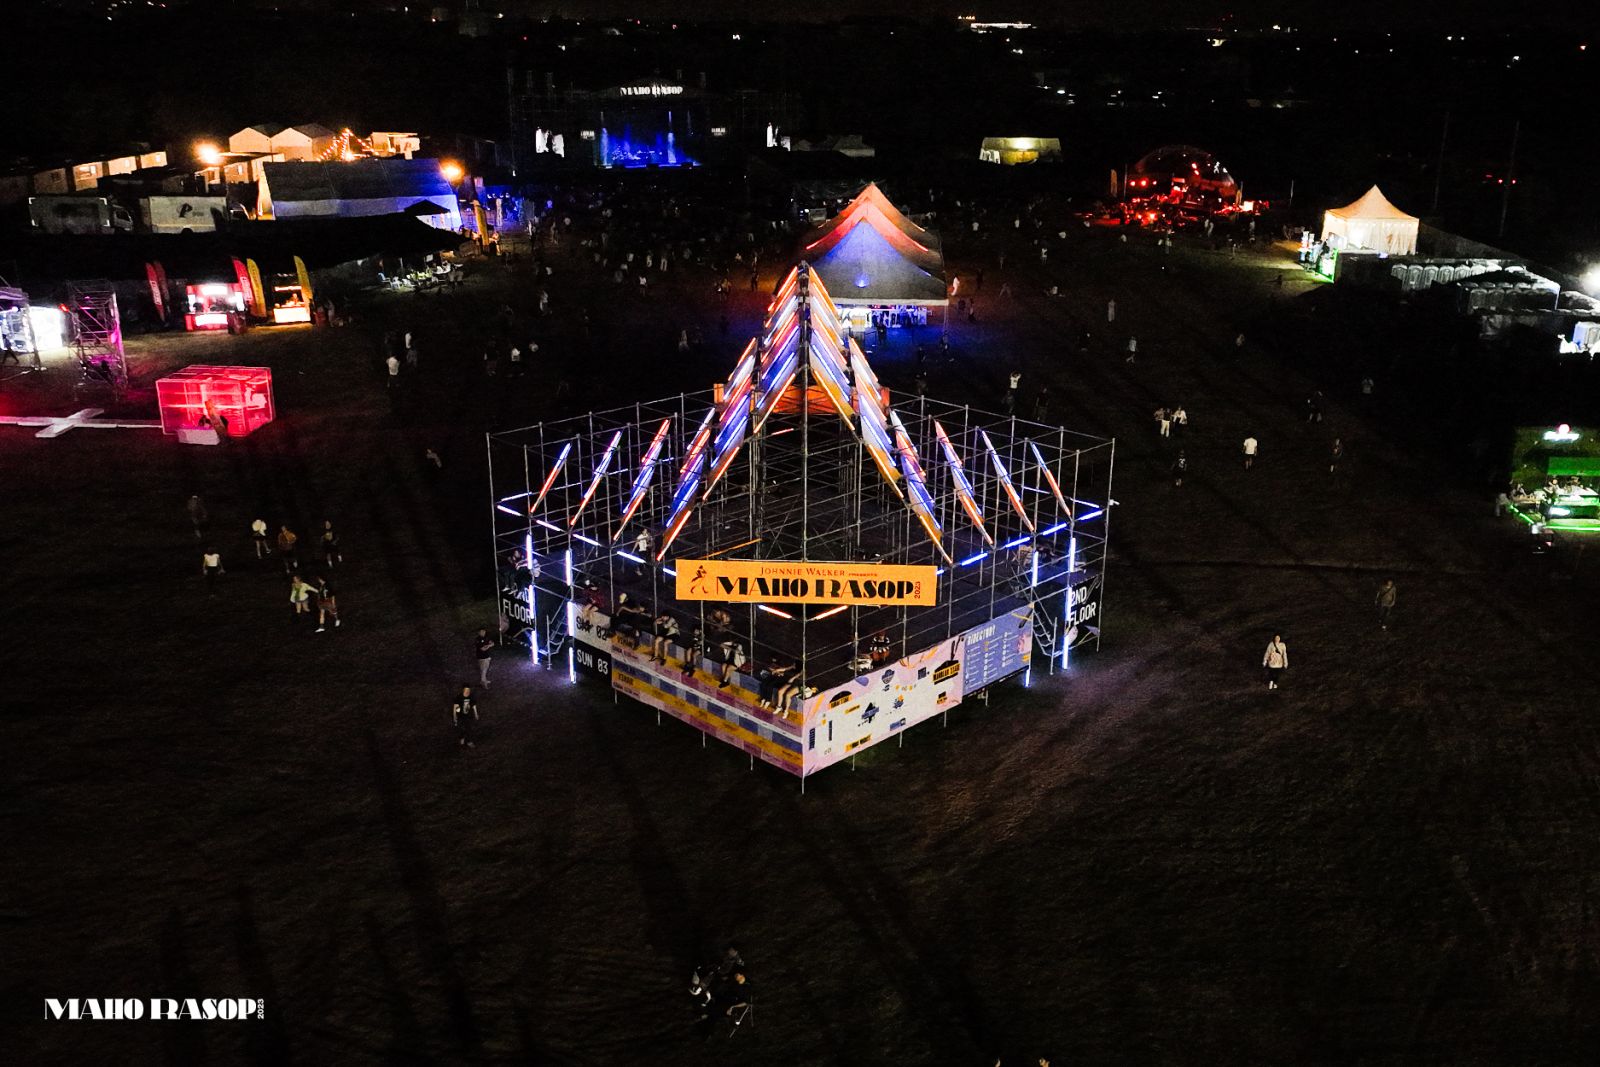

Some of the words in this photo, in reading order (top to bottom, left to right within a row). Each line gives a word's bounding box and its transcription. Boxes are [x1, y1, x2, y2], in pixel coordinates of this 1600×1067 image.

[620, 86, 650, 96] MAHO
[761, 566, 802, 576] JOHNNIE
[806, 567, 845, 577] WALKER
[716, 576, 809, 597] MAHO
[815, 579, 914, 599] RASOP
[1069, 586, 1087, 607] 2ND
[502, 598, 531, 625] FLOOR
[1068, 602, 1096, 628] FLOOR
[576, 650, 593, 668] SUN
[597, 659, 608, 675] 03
